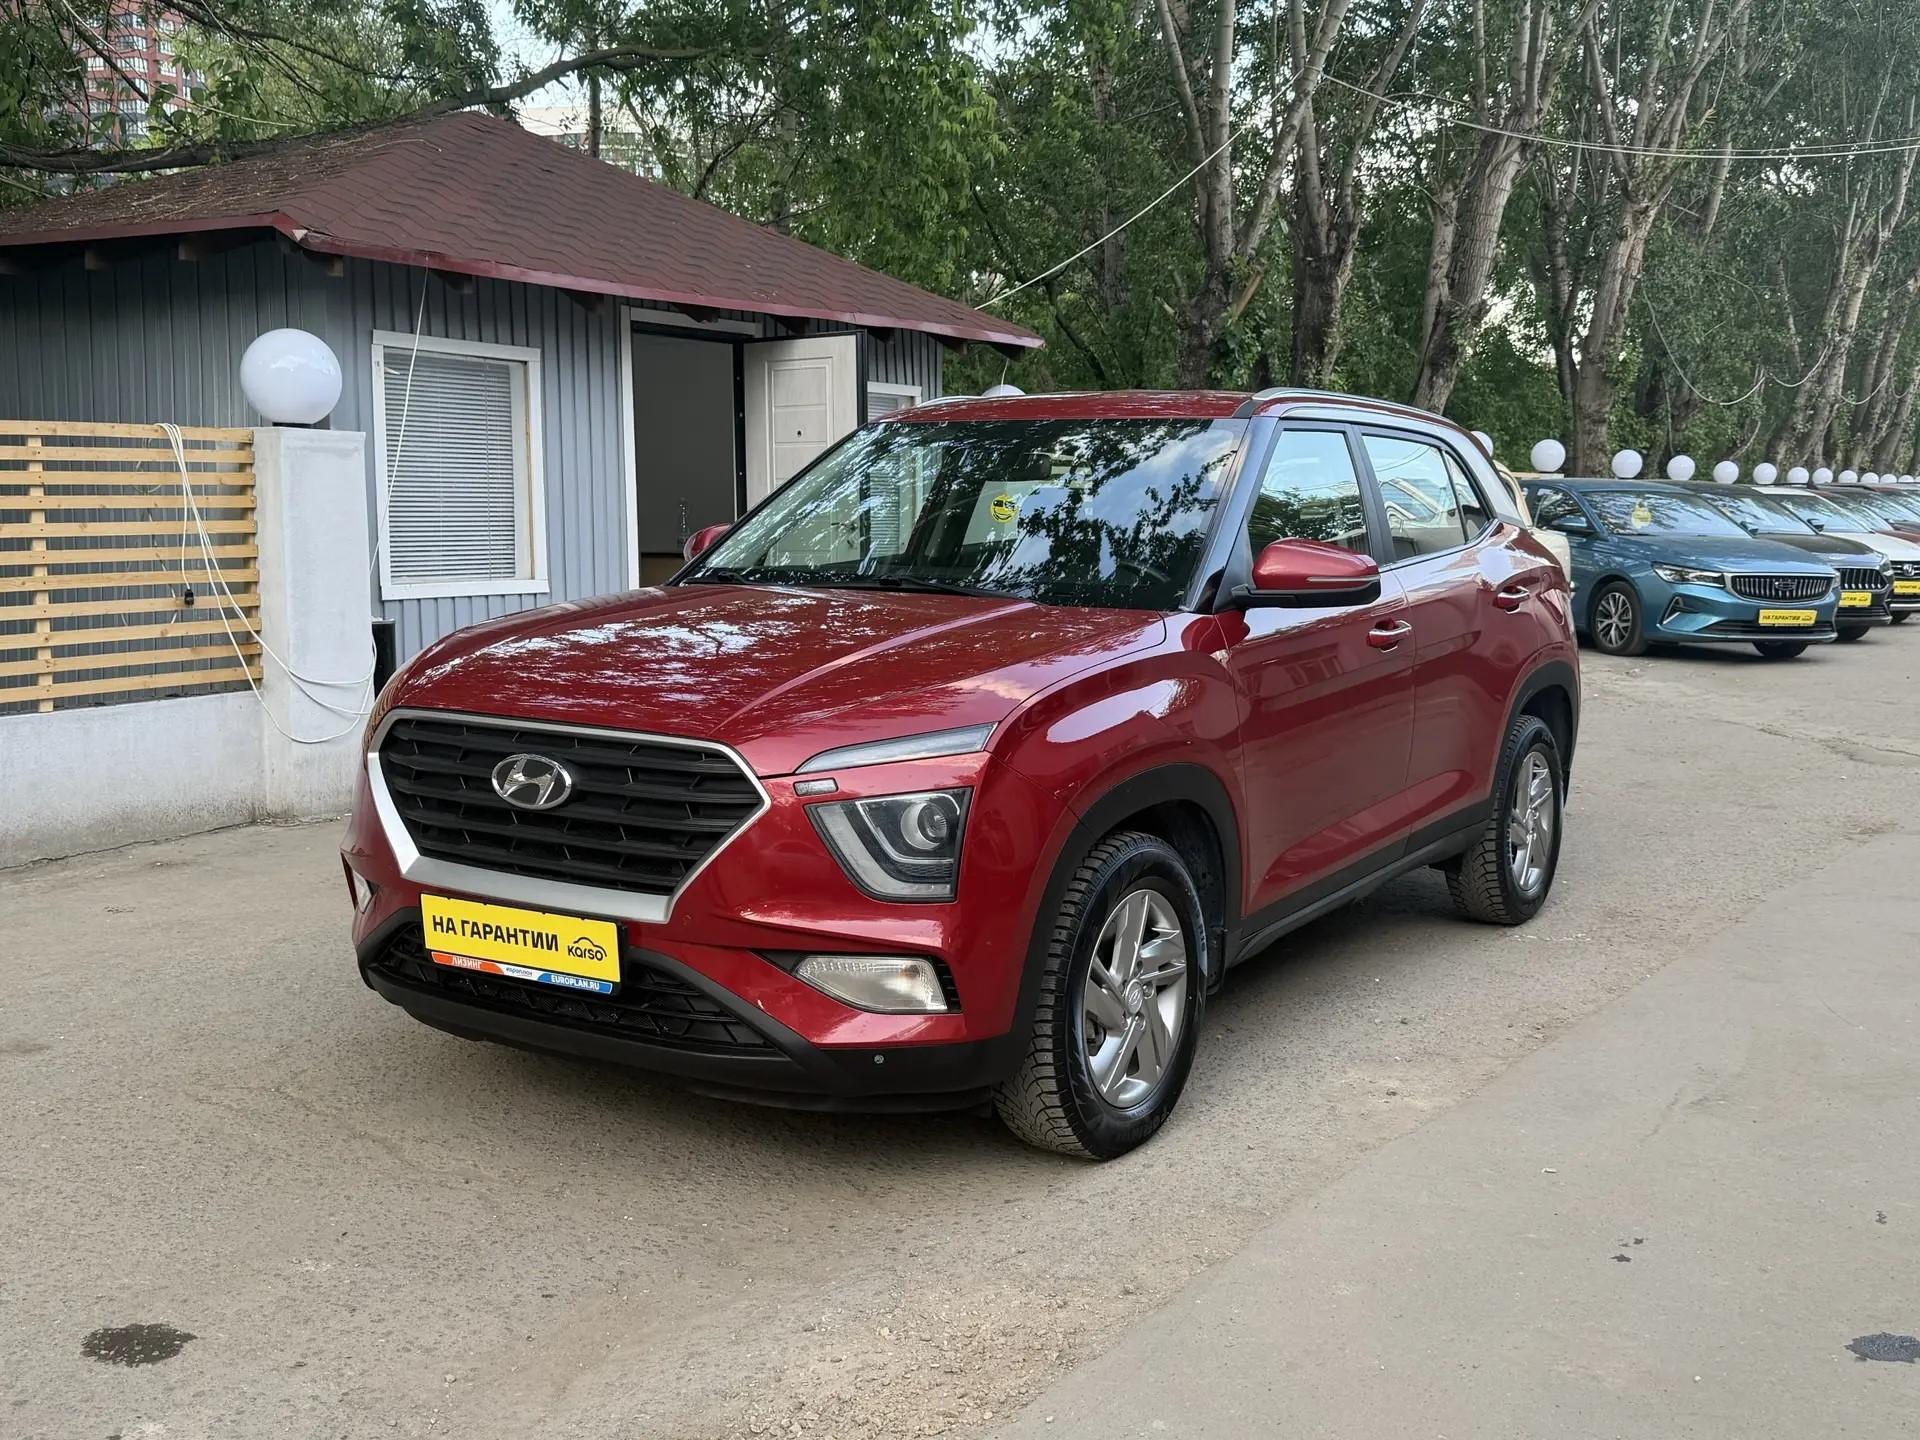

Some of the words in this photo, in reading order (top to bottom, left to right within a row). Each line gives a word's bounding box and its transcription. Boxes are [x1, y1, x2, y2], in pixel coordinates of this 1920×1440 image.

[432, 914, 458, 936] НА
[461, 919, 559, 952] ГАРАНТИИ
[453, 956, 481, 970] ЛИЗИНГ
[551, 975, 600, 990] EUROPLAN.RU
